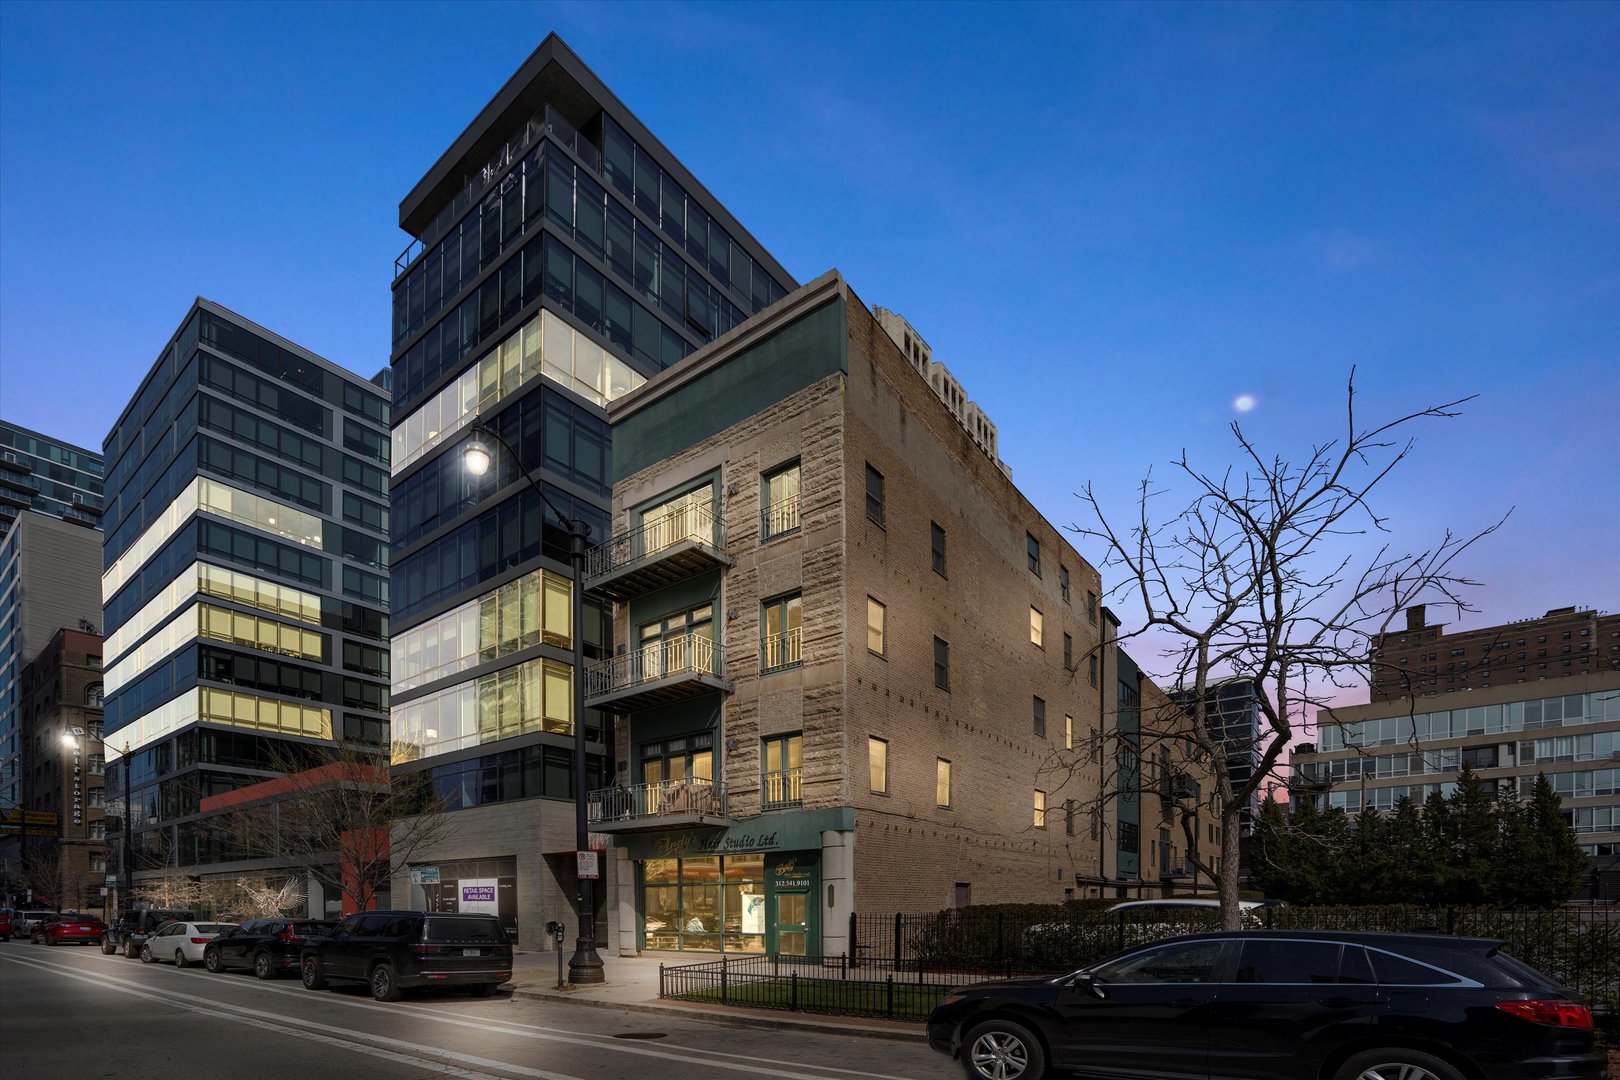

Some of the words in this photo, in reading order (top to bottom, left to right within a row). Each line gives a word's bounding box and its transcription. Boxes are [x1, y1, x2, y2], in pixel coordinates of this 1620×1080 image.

[699, 836, 721, 850] Hair
[723, 834, 754, 849] Studio
[756, 832, 778, 847] Ltd.
